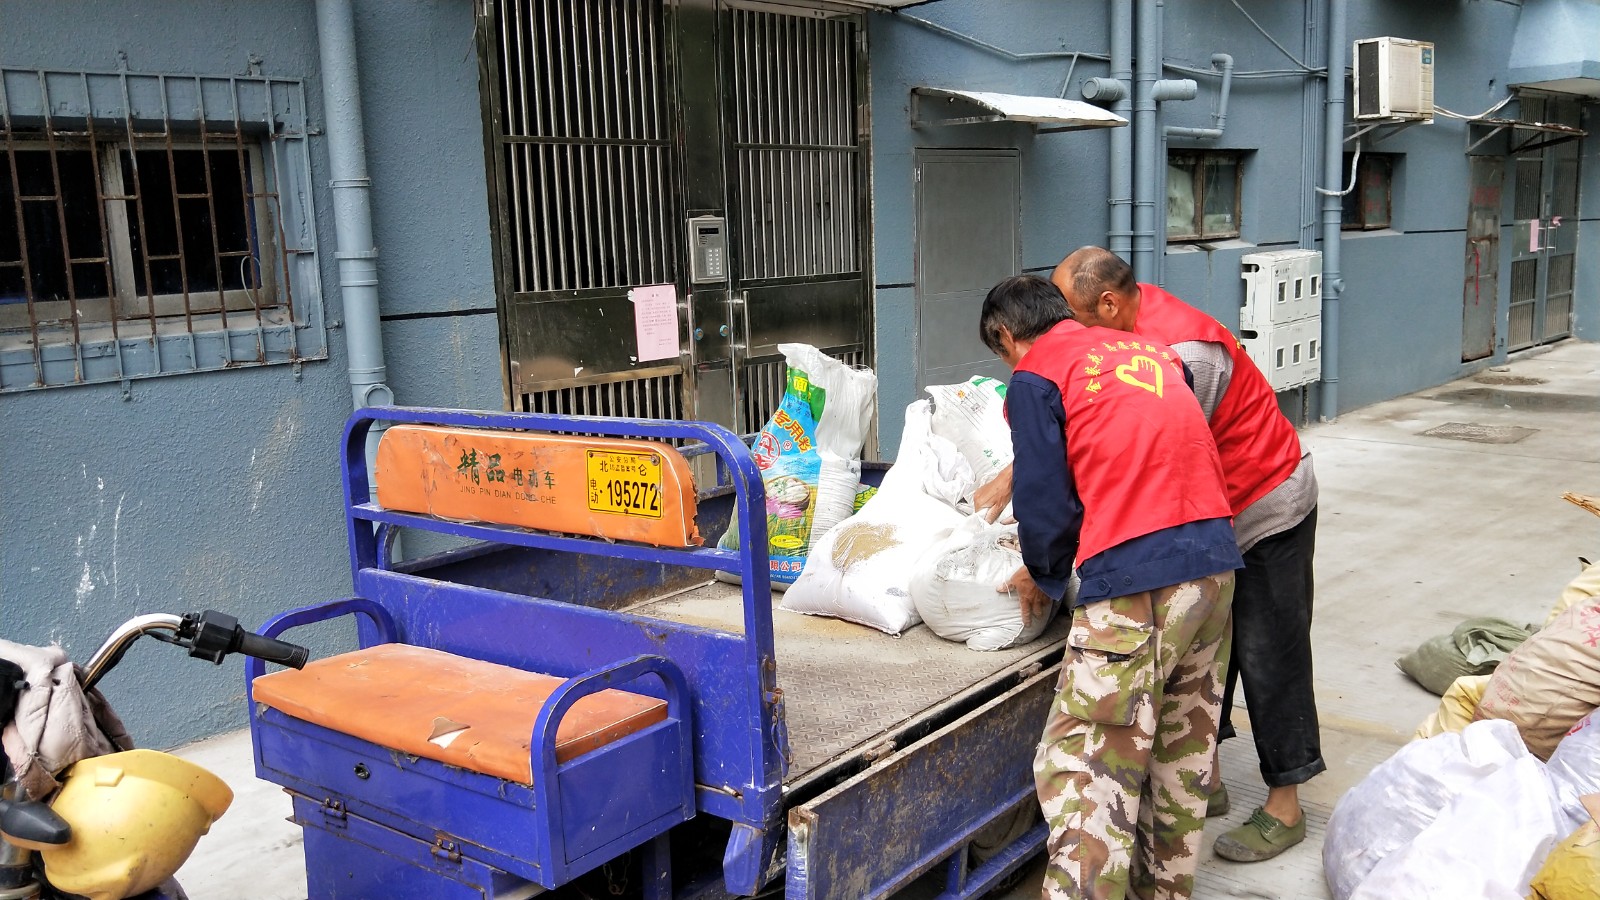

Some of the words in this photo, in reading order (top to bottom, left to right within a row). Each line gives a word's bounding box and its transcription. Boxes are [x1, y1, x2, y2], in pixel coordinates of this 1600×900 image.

[460, 485, 476, 494] JING
[479, 488, 491, 496] PIN
[495, 490, 511, 499] DIAN
[541, 495, 556, 505] CHE
[590, 478, 598, 504] 电动
[607, 480, 658, 511] 195272
